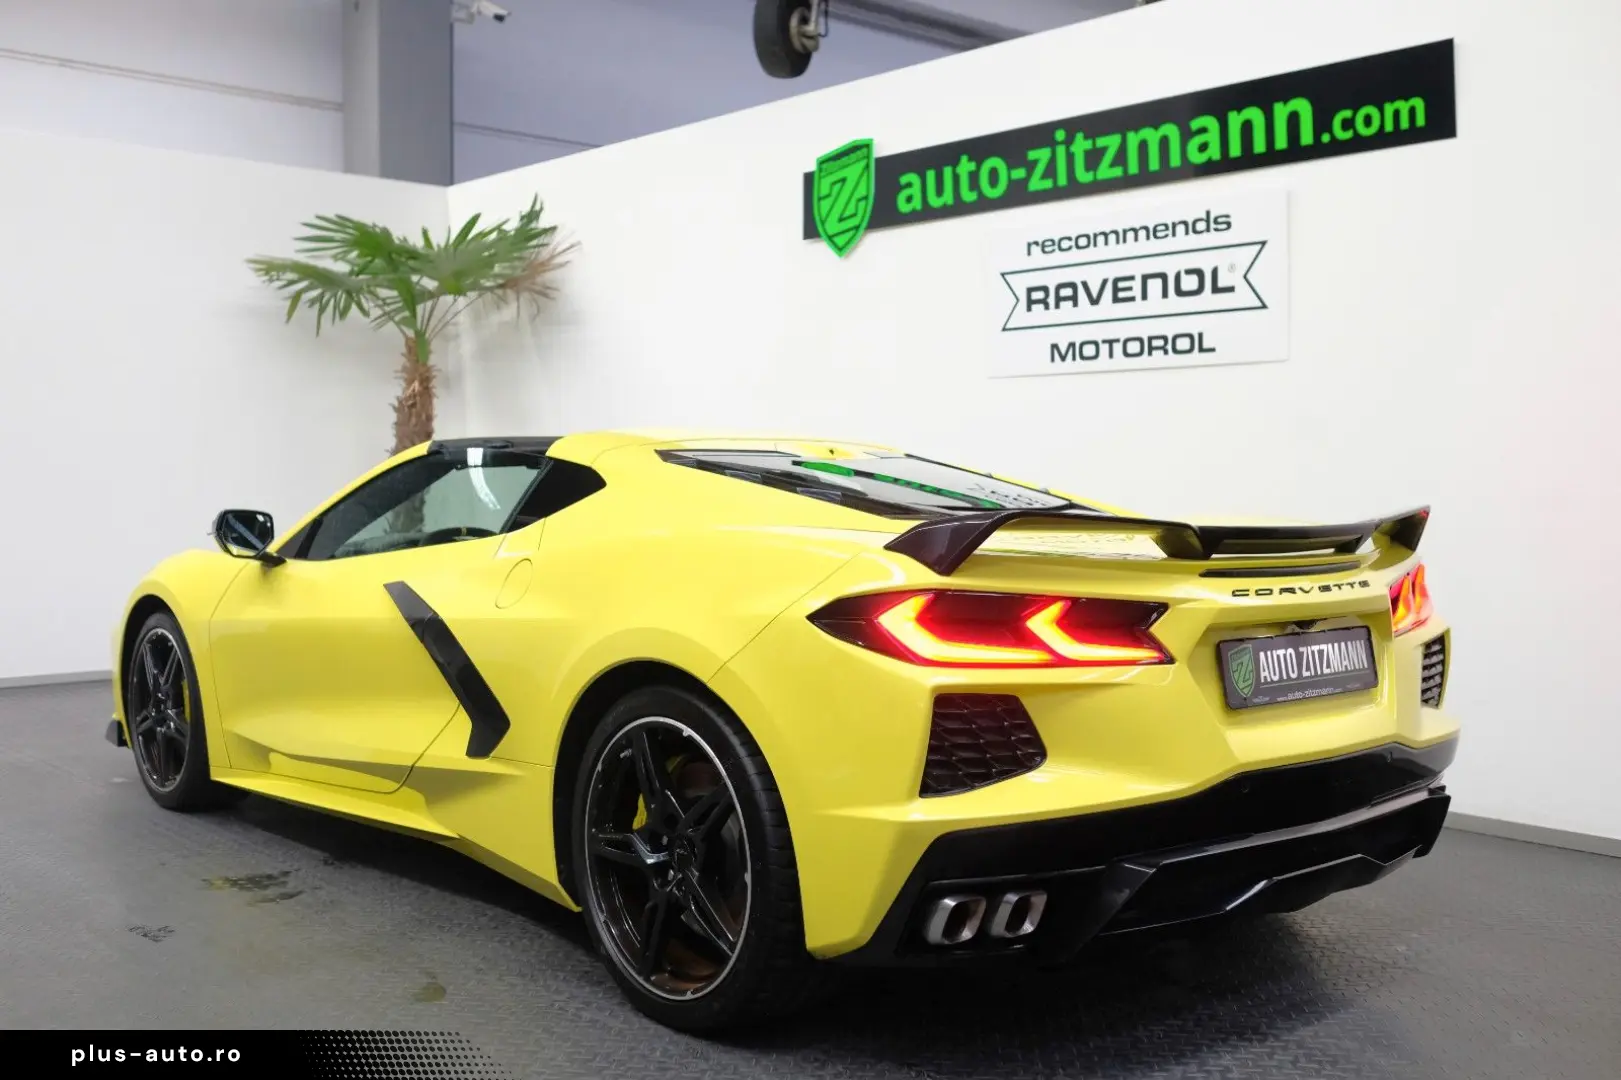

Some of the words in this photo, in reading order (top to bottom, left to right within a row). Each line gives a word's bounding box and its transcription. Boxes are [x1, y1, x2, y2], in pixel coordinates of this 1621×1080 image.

[896, 96, 1427, 214] auto-zitzmann.com
[1027, 209, 1232, 256] recommends
[1026, 265, 1235, 312] RAVENOL
[1050, 331, 1216, 363] MOTOROL
[1232, 580, 1370, 597] CORVETTE
[1259, 647, 1297, 683] AUTO
[1299, 640, 1368, 677] ZITZMANN
